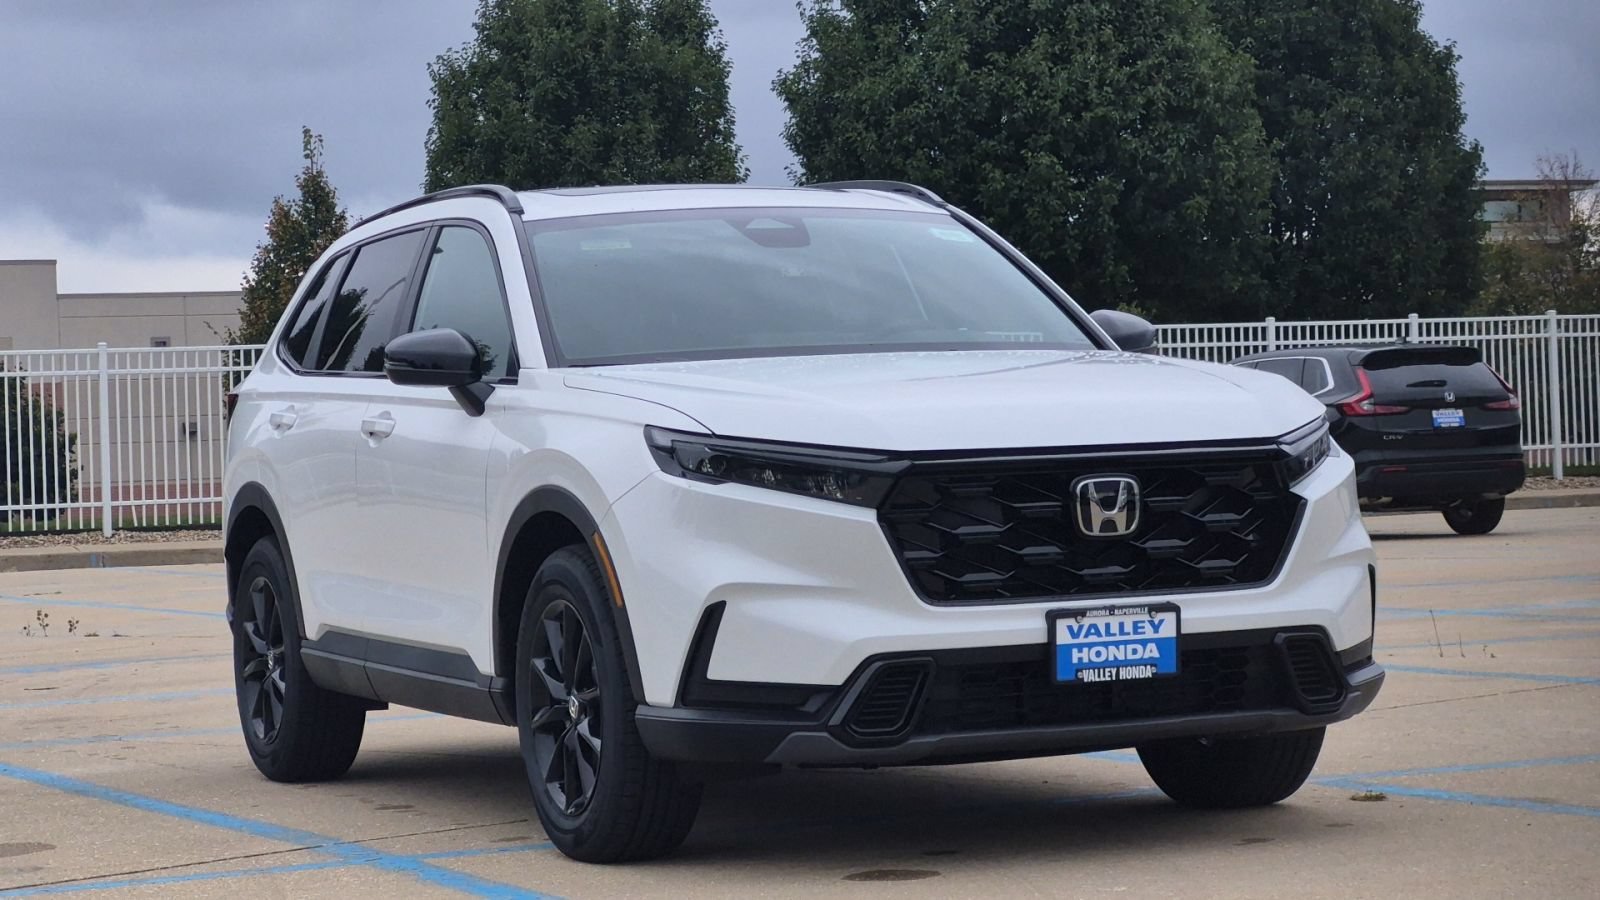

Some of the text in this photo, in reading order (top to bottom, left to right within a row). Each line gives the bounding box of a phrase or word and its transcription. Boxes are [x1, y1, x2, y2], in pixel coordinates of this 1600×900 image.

[1086, 607, 1148, 617] AURORA NAPERVILLE
[1066, 618, 1165, 640] VALLEY
[1071, 642, 1160, 664] HONDA
[1082, 664, 1152, 682] VALLEY HONDA
